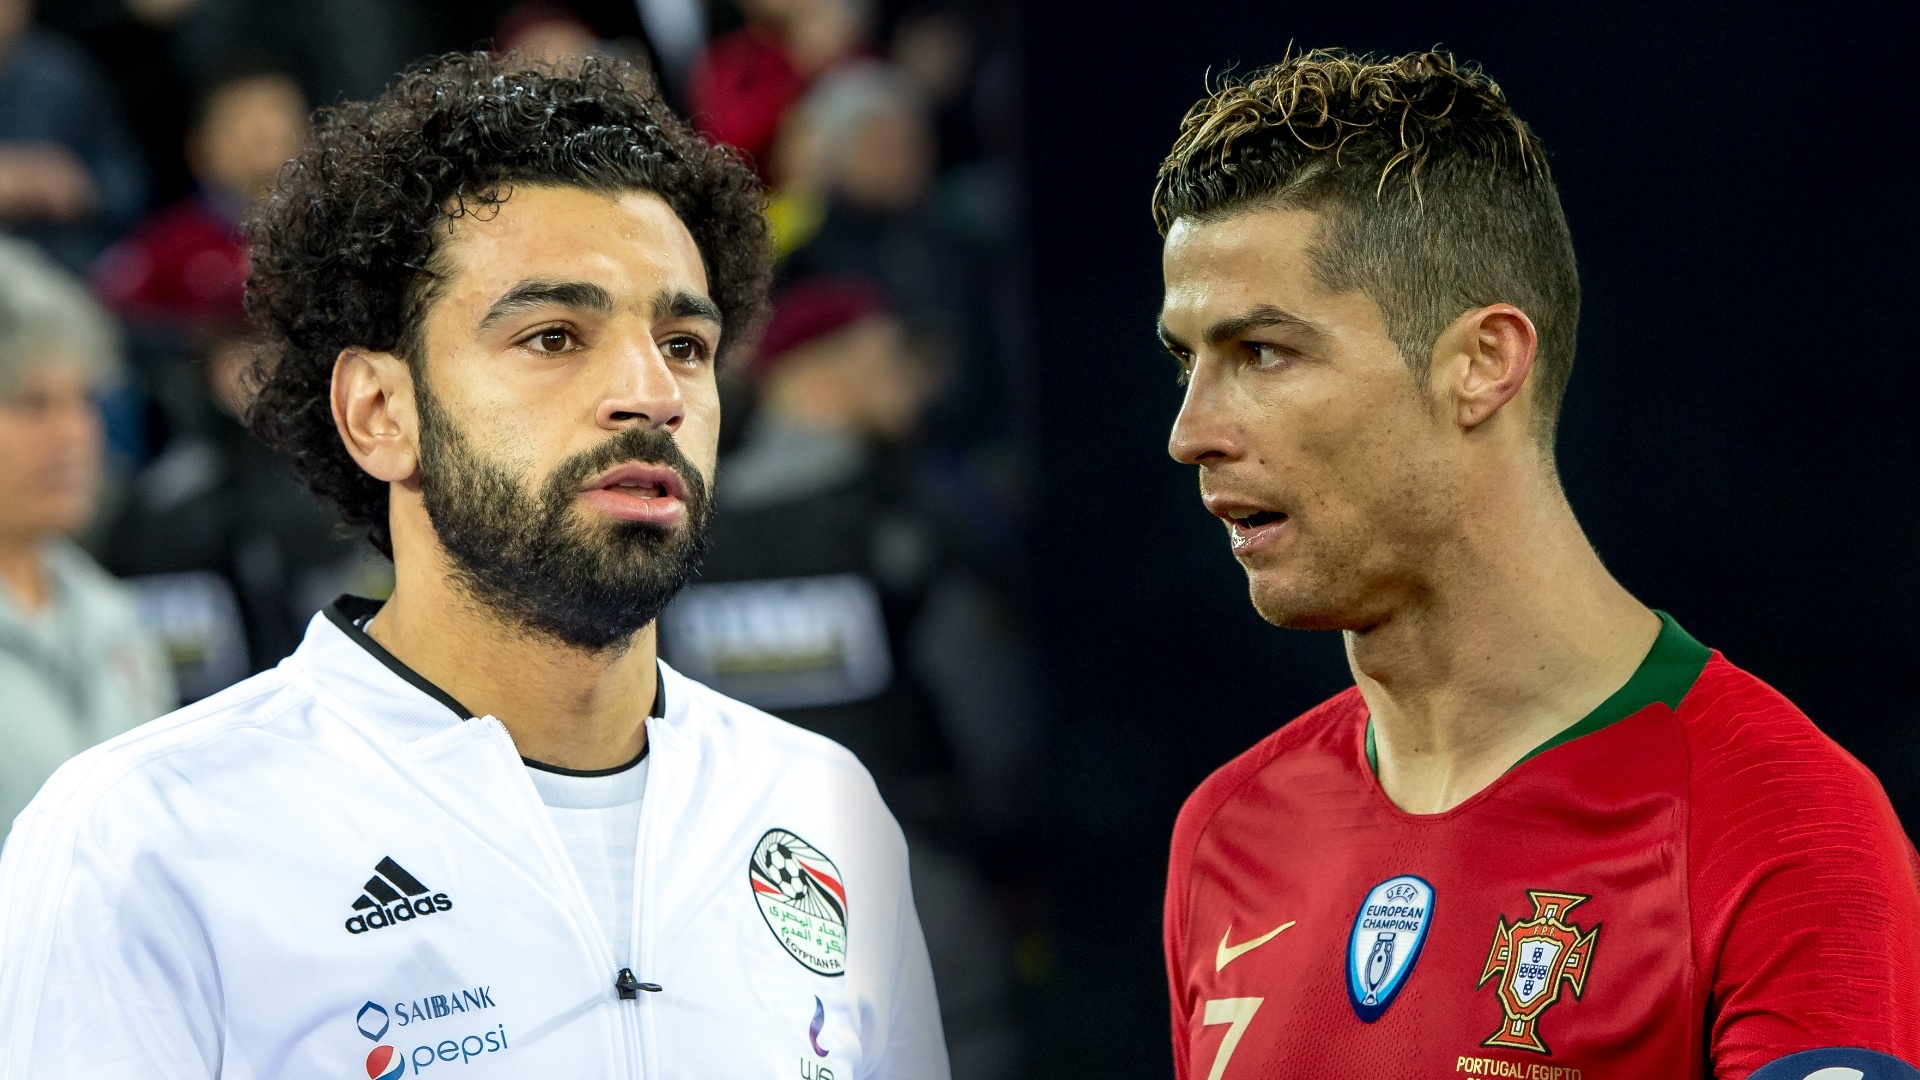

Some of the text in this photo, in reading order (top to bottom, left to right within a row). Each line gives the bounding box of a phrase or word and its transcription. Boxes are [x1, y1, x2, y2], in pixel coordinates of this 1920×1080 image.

[1386, 886, 1415, 901] UEFA
[345, 893, 453, 934] adidas
[1362, 918, 1419, 931] CHAMPIONS
[1366, 905, 1424, 919] EUROPEAN
[785, 936, 842, 970] EGYPTIAN FA
[412, 1024, 508, 1075] pepsi
[1203, 997, 1265, 1080] 7
